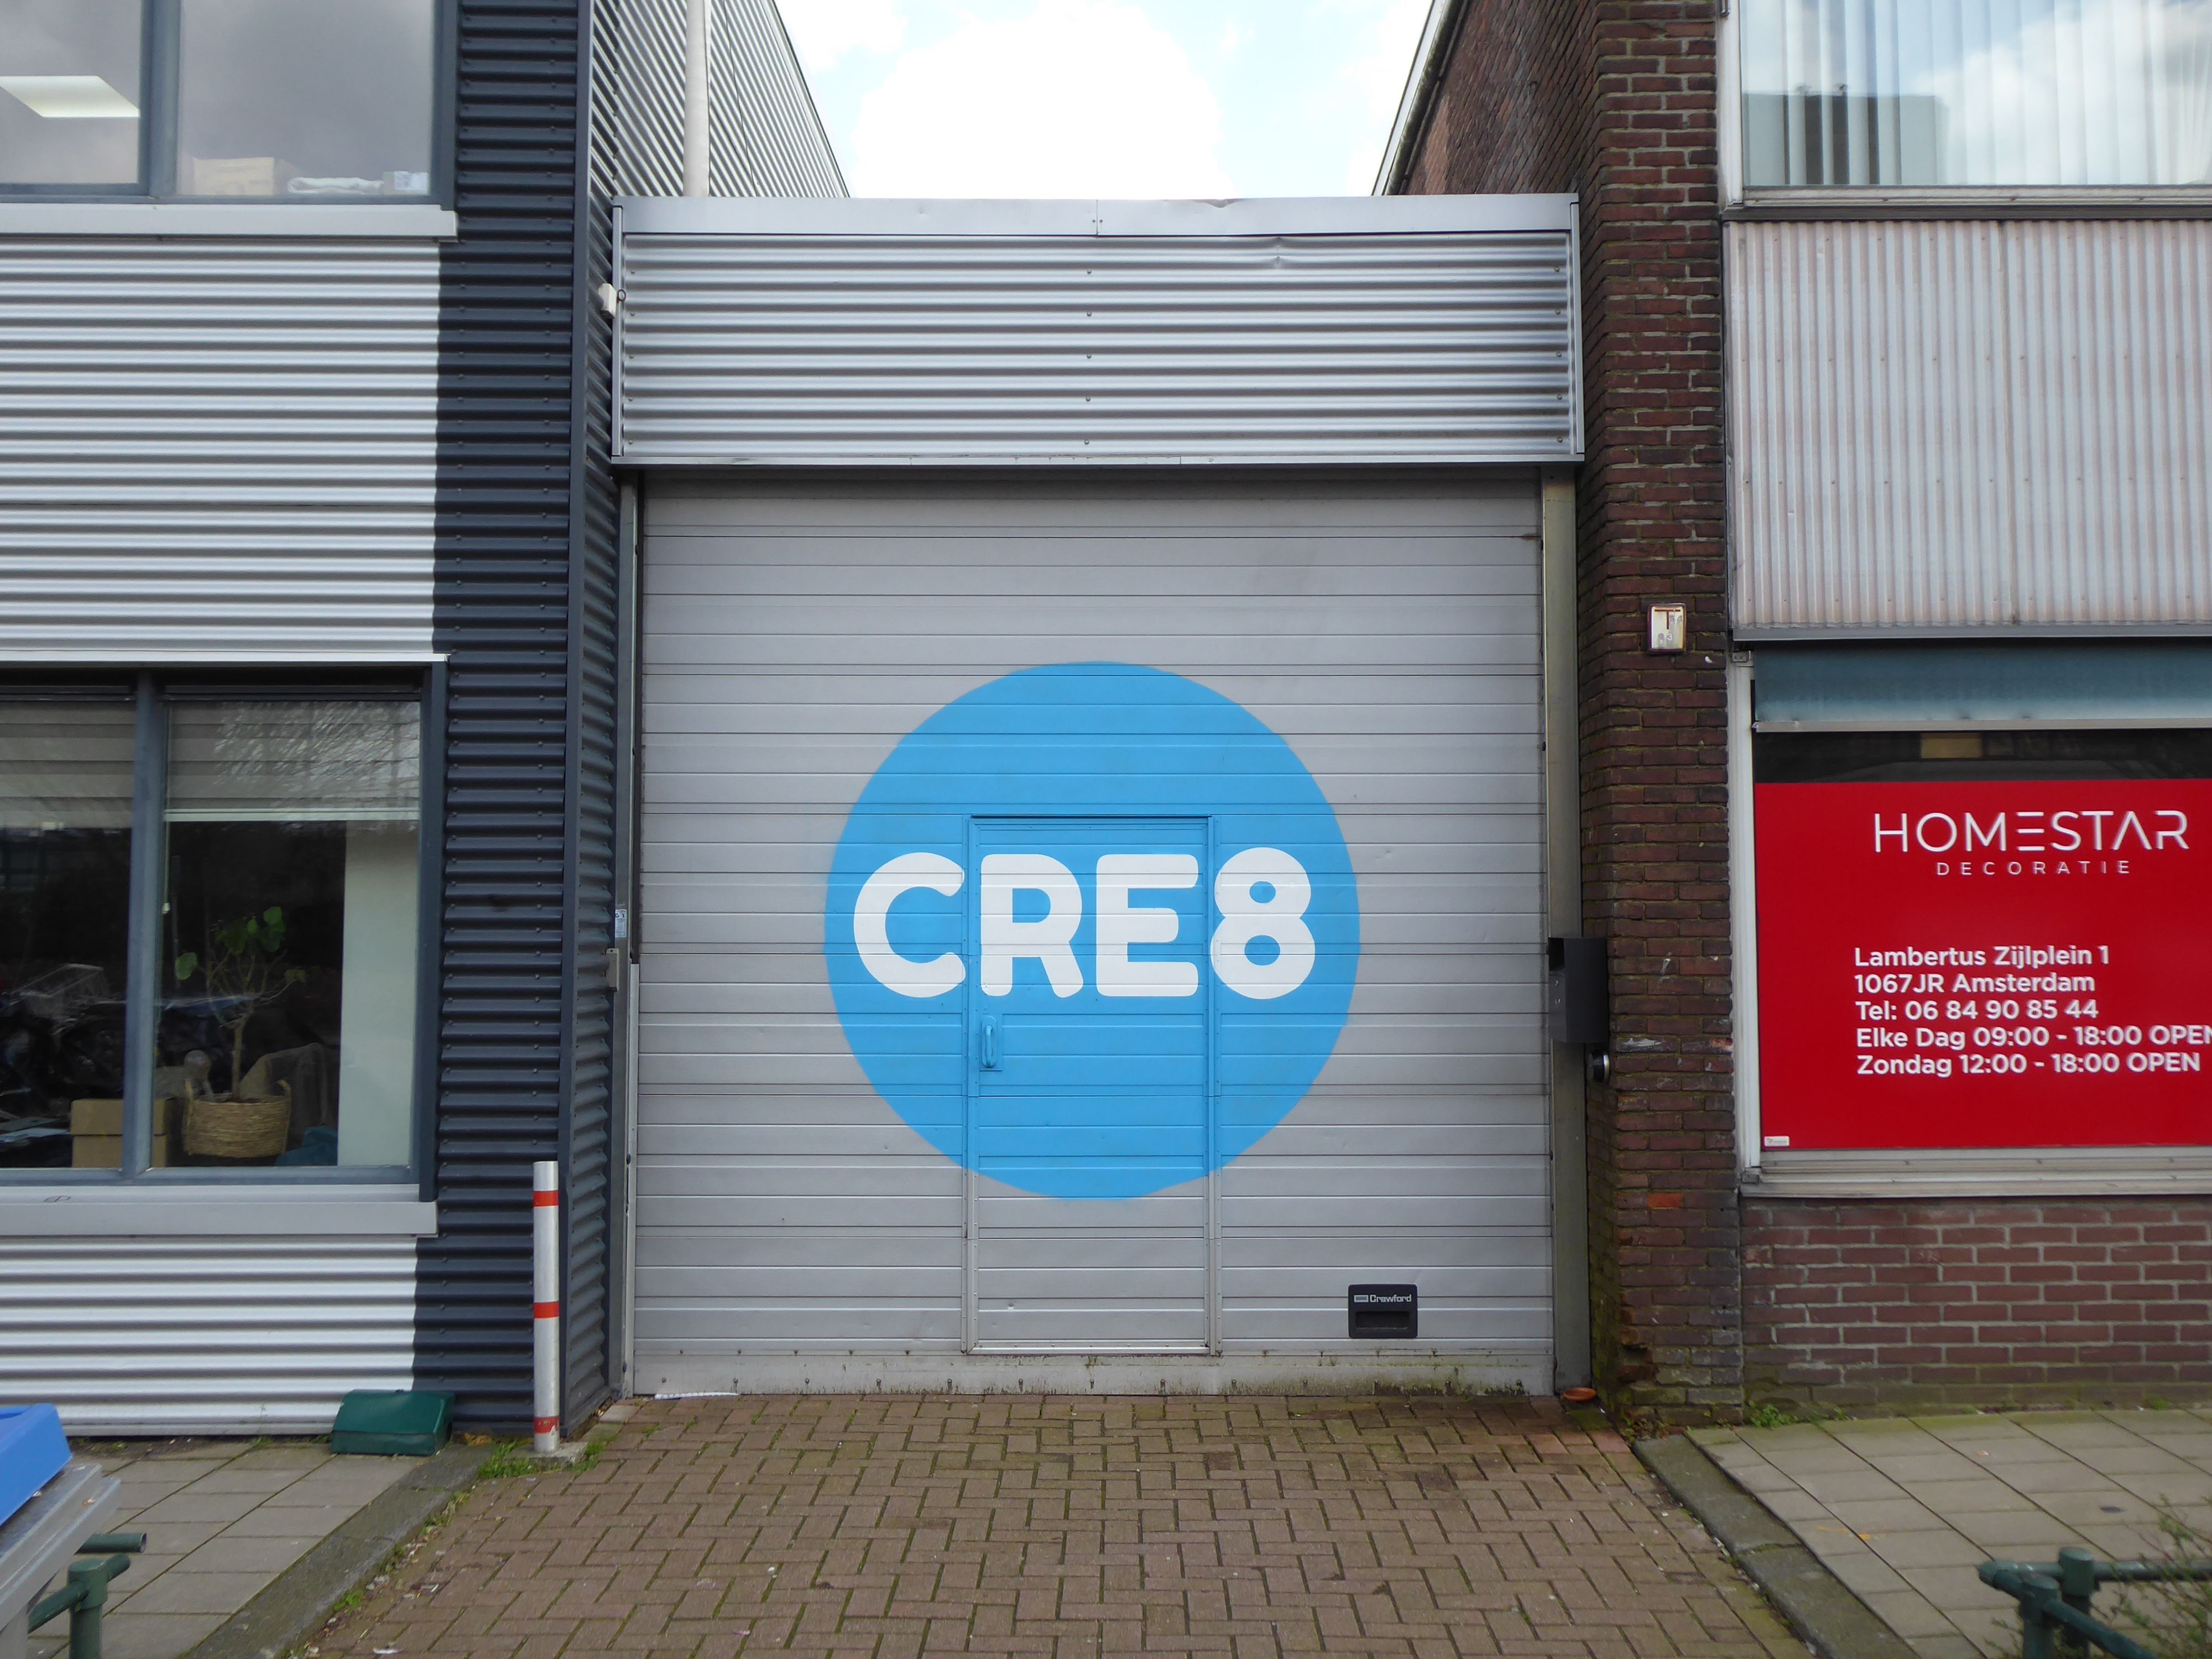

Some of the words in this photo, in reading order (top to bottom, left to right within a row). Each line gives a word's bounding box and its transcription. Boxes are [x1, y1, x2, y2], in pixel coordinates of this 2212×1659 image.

[1875, 811, 2189, 852] HOMESTAR
[1937, 860, 2130, 875] DECORATIE
[853, 847, 1316, 999] CRE8
[1855, 946, 1986, 967] Lambertus
[1994, 945, 2092, 969] Zijlplein
[2099, 945, 2109, 964] 1
[1854, 973, 1944, 994] 1067JR
[1952, 972, 2095, 993] Amsterdam
[1855, 1000, 1897, 1020] Tel:
[1905, 1000, 1938, 1020] 06
[1946, 1000, 1979, 1020] 84
[1986, 999, 2020, 1020] 90
[2027, 999, 2058, 1019] 85
[2064, 999, 2099, 1019] 44
[1857, 1027, 1908, 1047] Elke
[1916, 1027, 1965, 1051] Dag
[1973, 1026, 2049, 1047] 09:00
[2074, 1025, 2142, 1046] 18:00
[1857, 1054, 1952, 1078] Zondag
[1959, 1053, 2027, 1073] 12:00
[2051, 1052, 2120, 1073] 18:00
[2127, 1052, 2200, 1072] OPEN
[1369, 1294, 1412, 1302] Crawford
